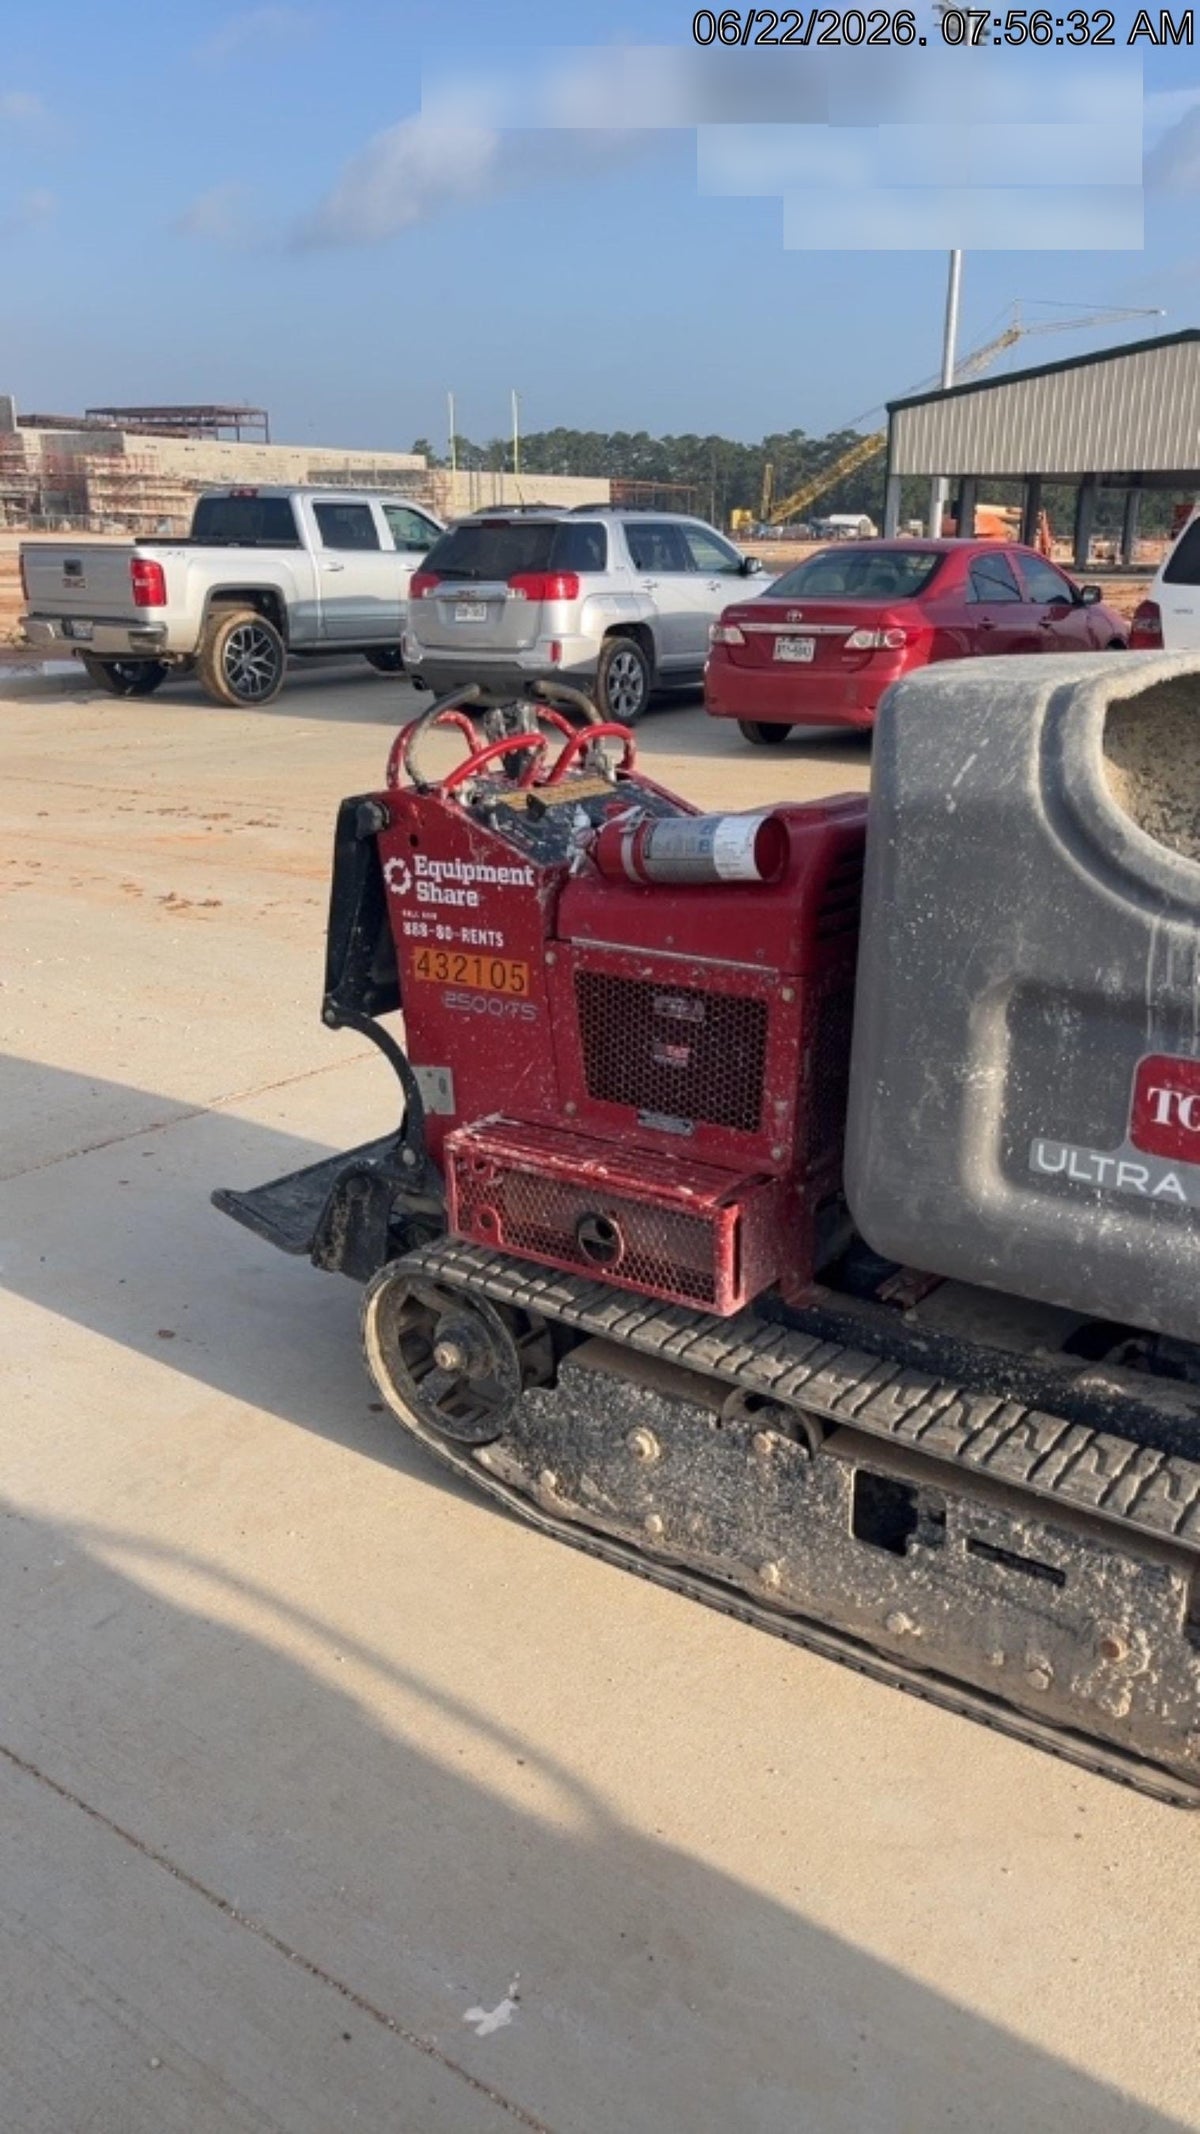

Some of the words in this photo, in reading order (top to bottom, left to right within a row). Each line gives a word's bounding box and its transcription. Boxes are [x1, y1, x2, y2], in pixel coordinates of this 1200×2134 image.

[413, 855, 535, 887] Equipment
[416, 881, 480, 907] Share
[416, 950, 526, 992] 432105
[1037, 1143, 1188, 1202] ULTRA
